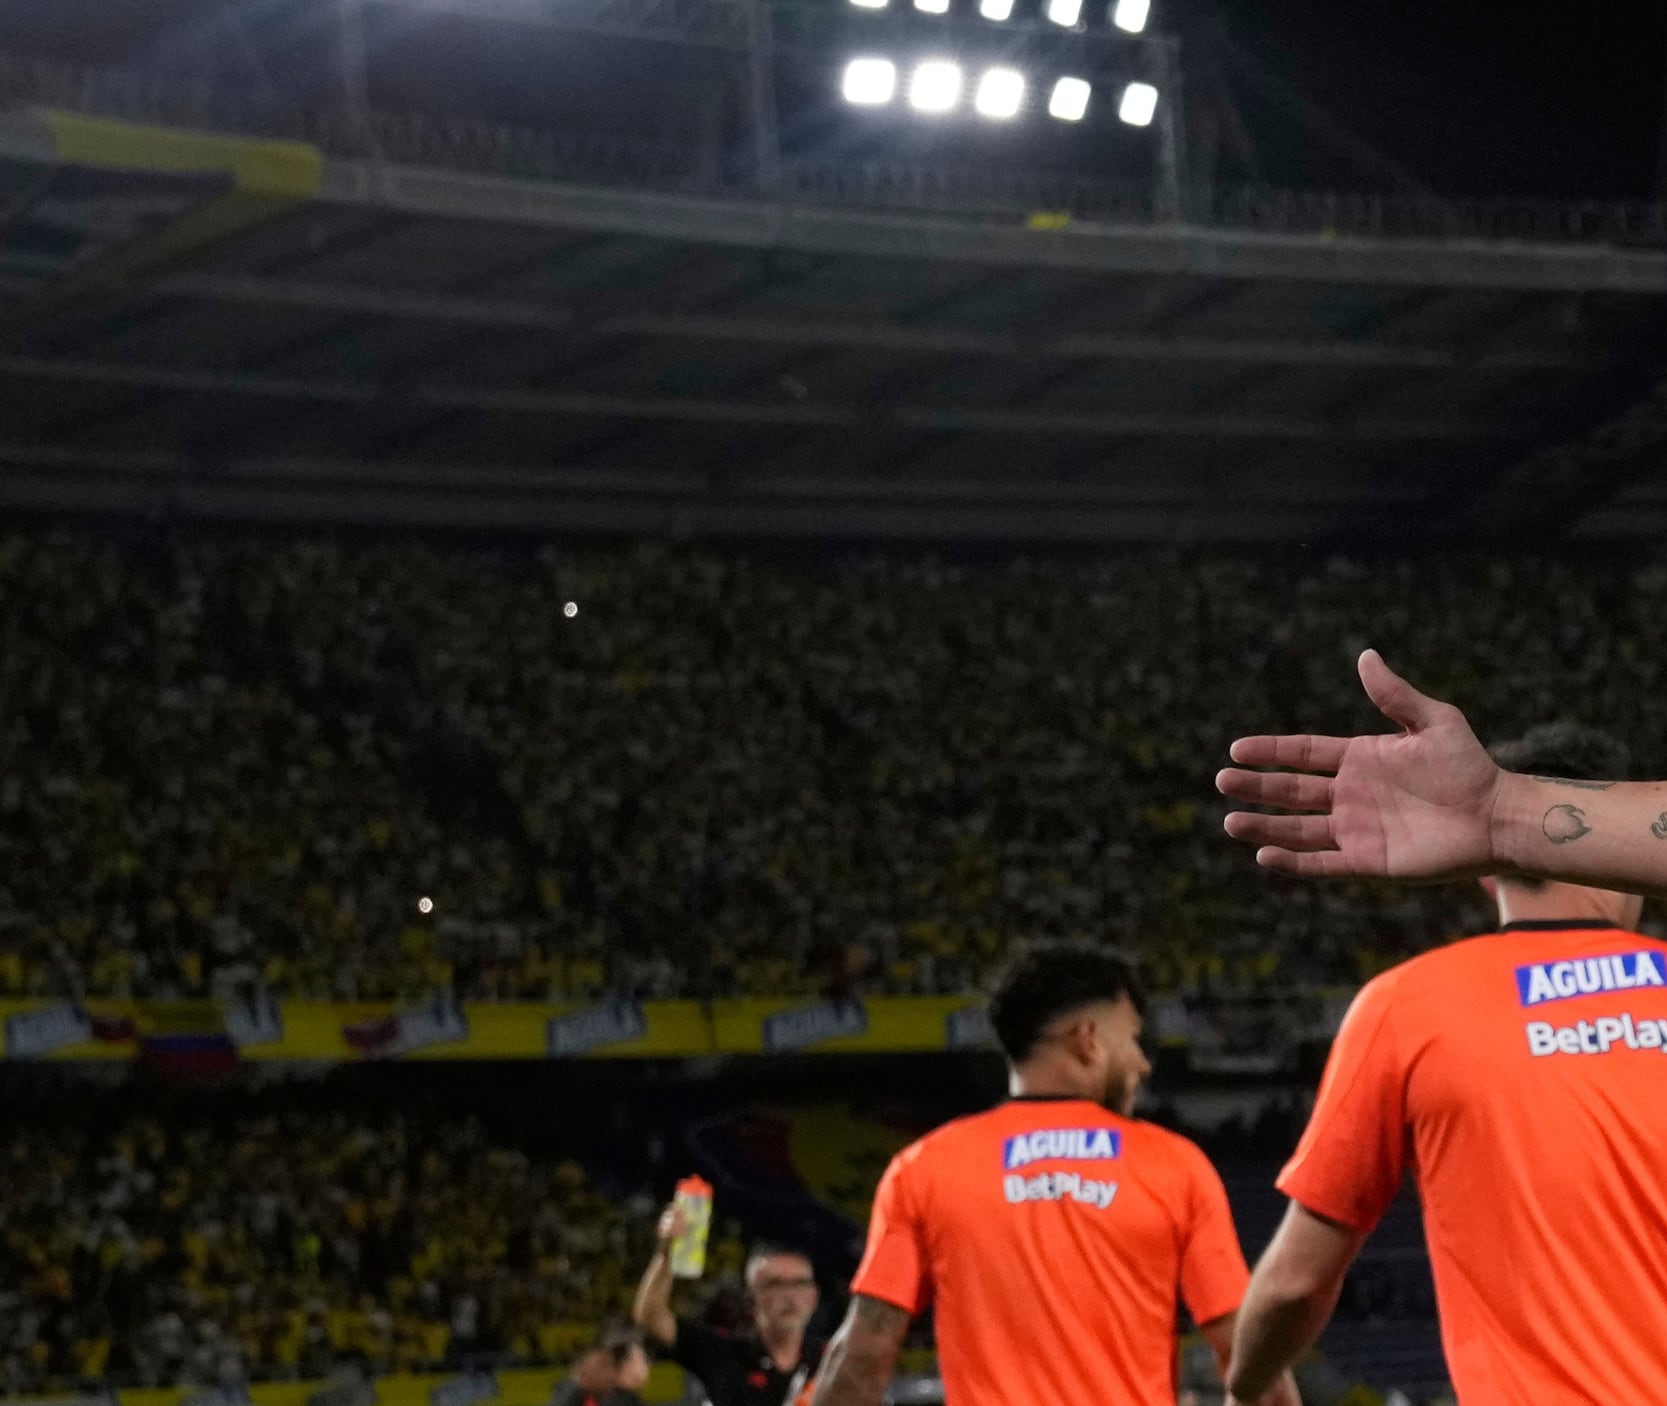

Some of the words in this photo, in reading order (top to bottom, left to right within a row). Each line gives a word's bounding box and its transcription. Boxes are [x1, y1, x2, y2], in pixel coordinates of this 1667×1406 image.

[1526, 951, 1664, 1005] AGUILA
[1008, 1129, 1115, 1169] AGUILA
[1004, 1171, 1118, 1209] BetPlay
